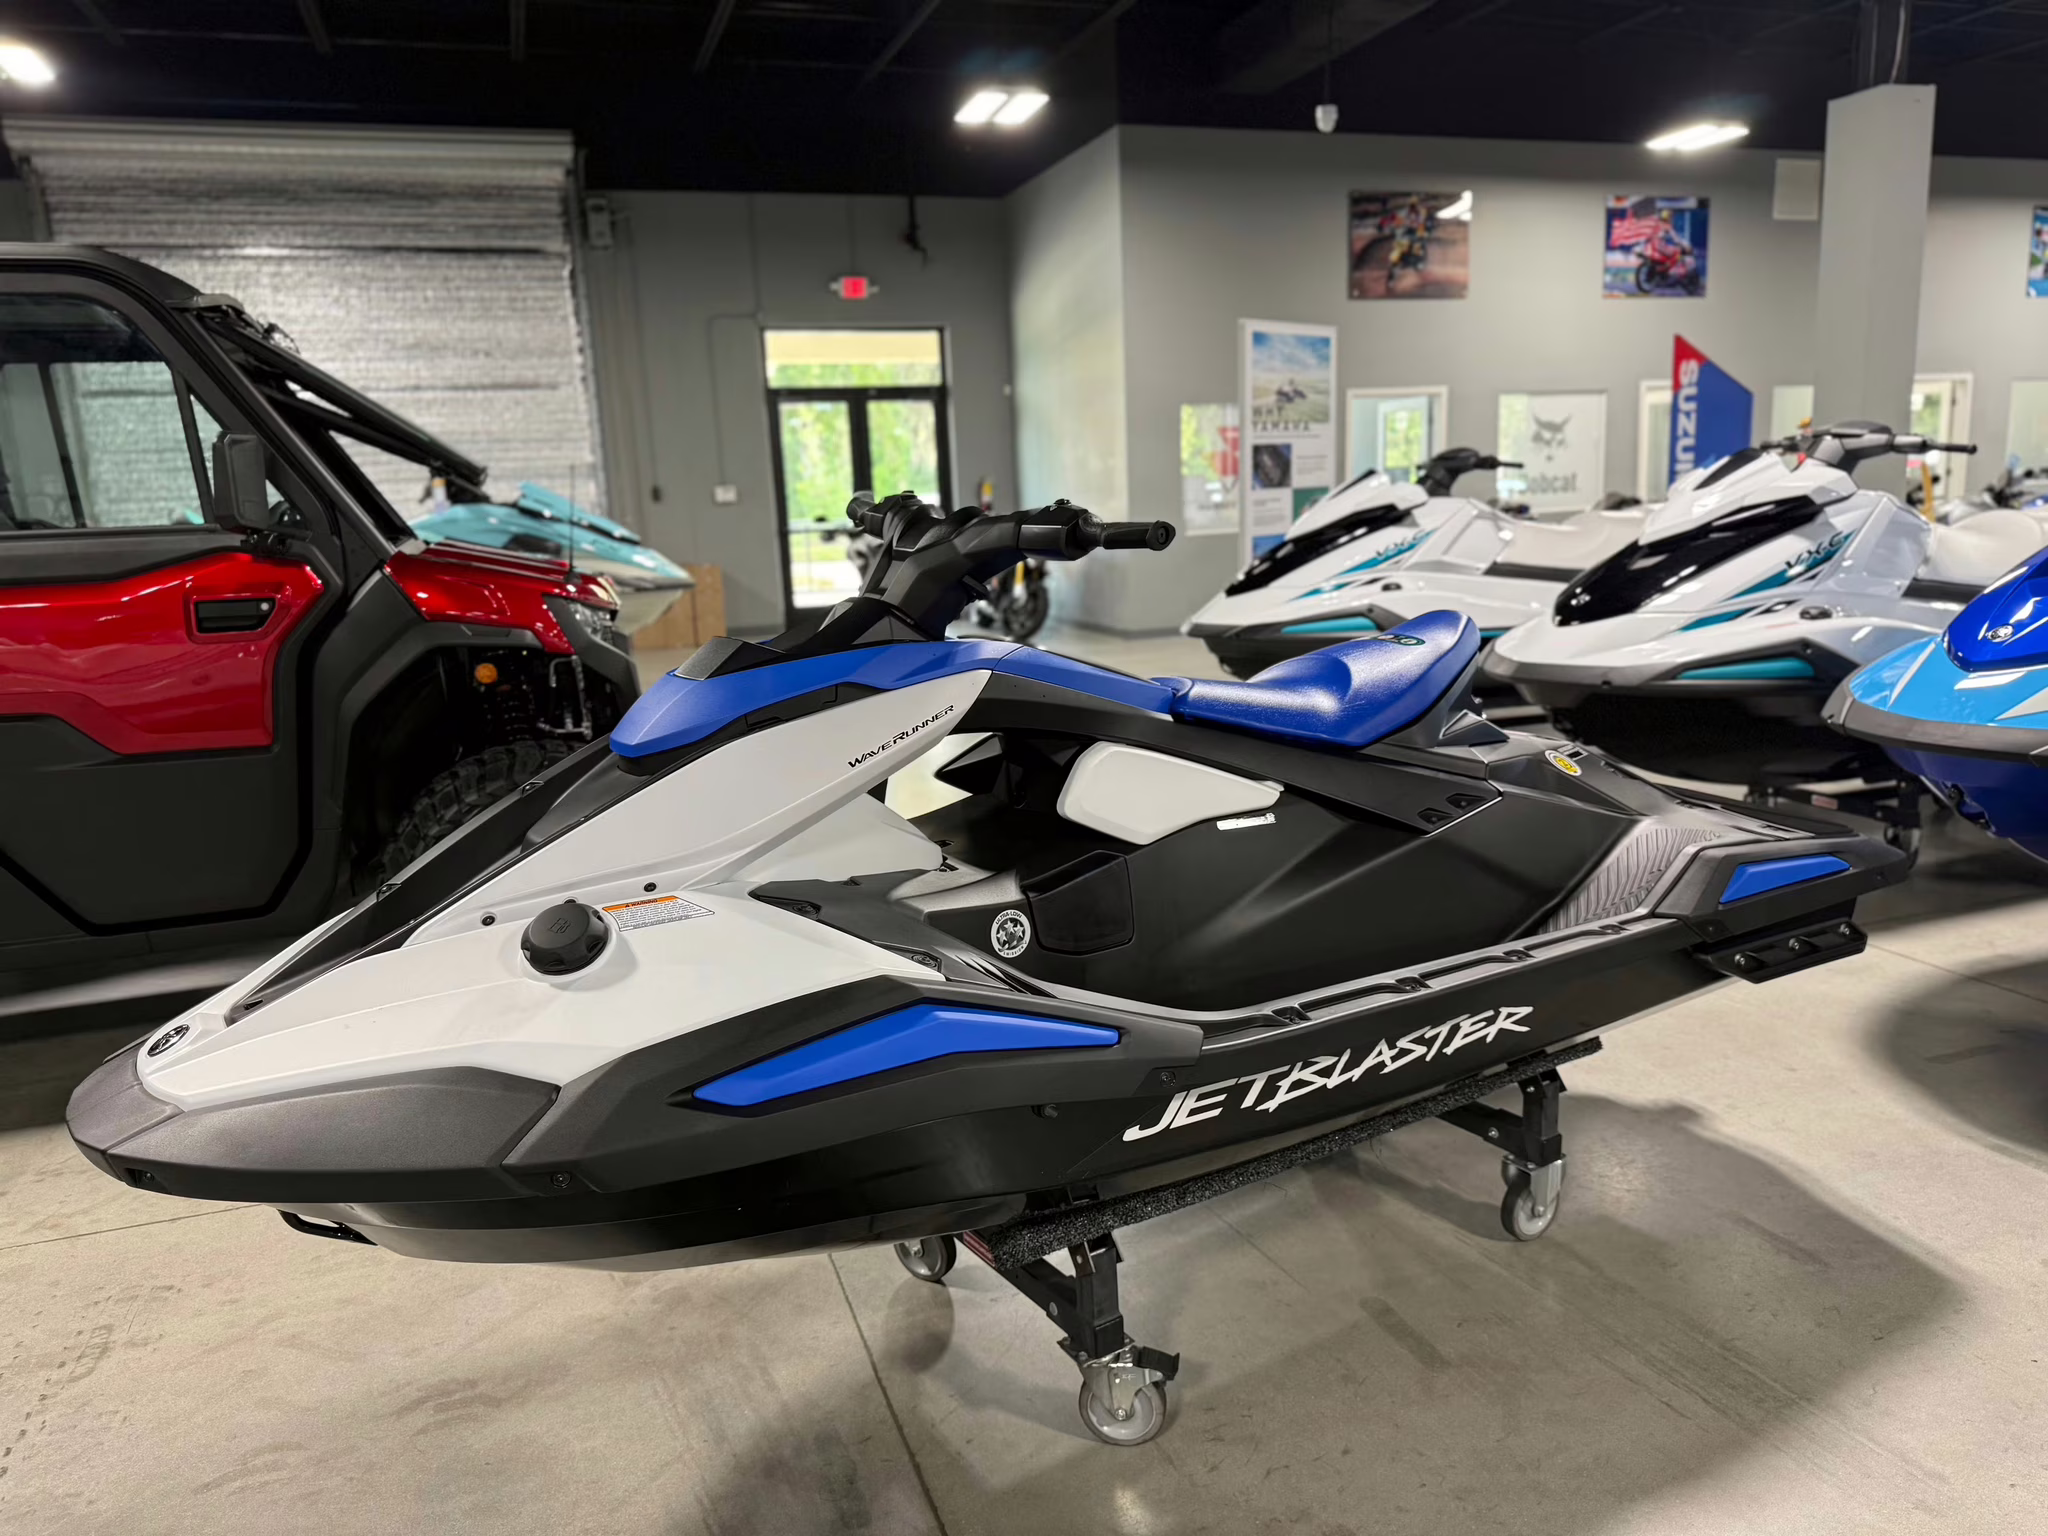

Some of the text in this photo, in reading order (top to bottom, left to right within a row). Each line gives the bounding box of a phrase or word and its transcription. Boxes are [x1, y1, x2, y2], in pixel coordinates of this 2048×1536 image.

[1253, 420, 1310, 432] YAMAHA
[631, 899, 658, 908] WARNING
[1122, 1006, 1534, 1142] JETBLASTER
